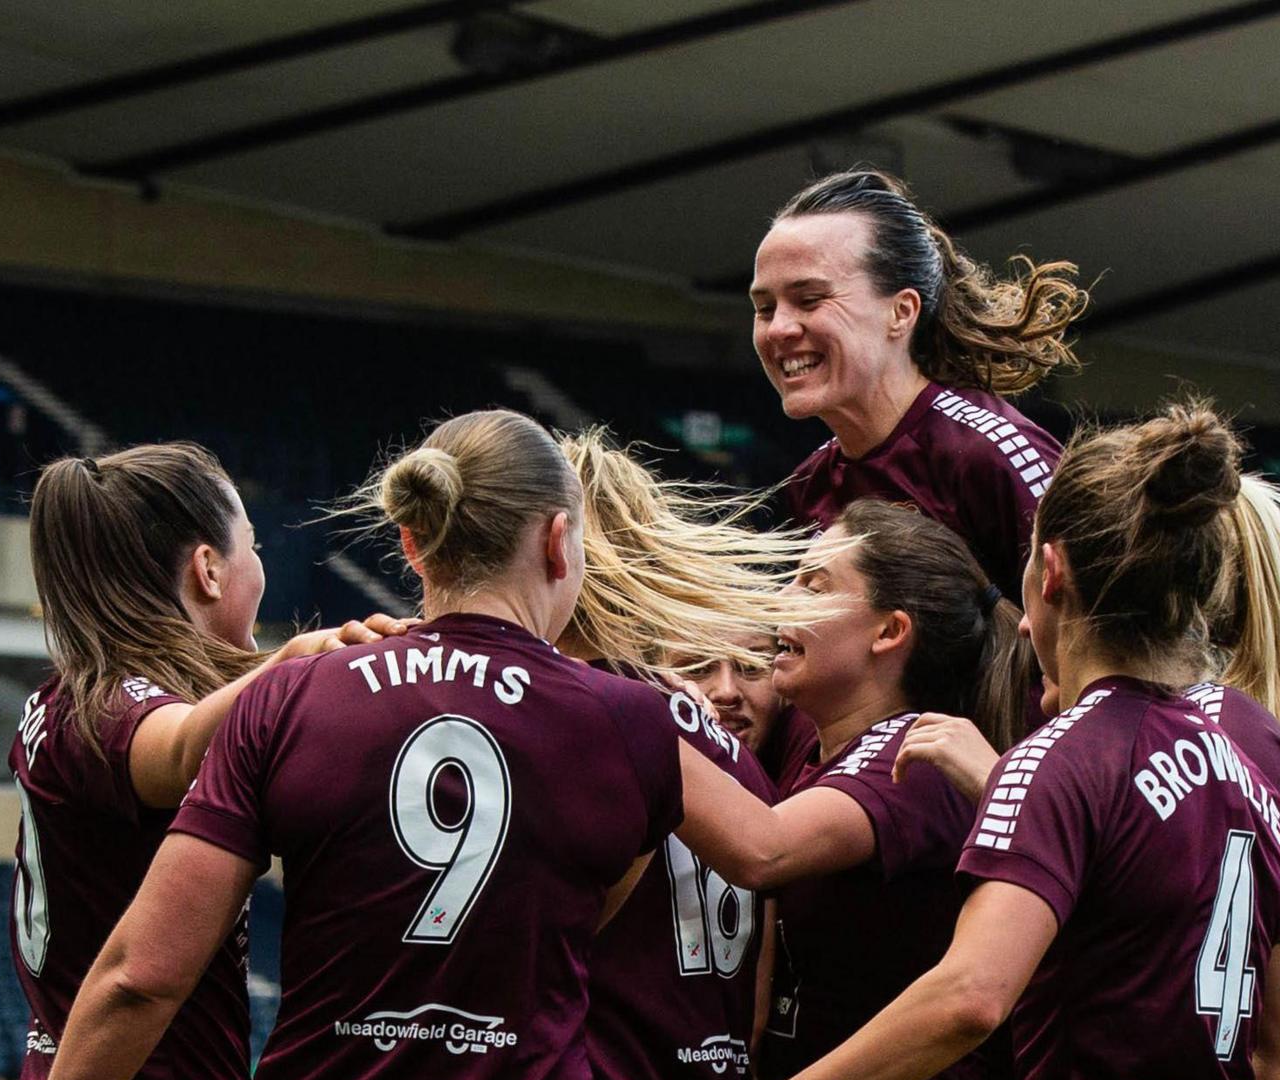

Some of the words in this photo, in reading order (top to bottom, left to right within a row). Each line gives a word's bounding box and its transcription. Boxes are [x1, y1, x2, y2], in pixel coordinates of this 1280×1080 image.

[348, 646, 531, 704] TIMMS
[389, 713, 512, 944] 9
[1195, 829, 1256, 1061] 4
[334, 1021, 446, 1040] Meadowfield
[450, 1023, 517, 1047] Garage
